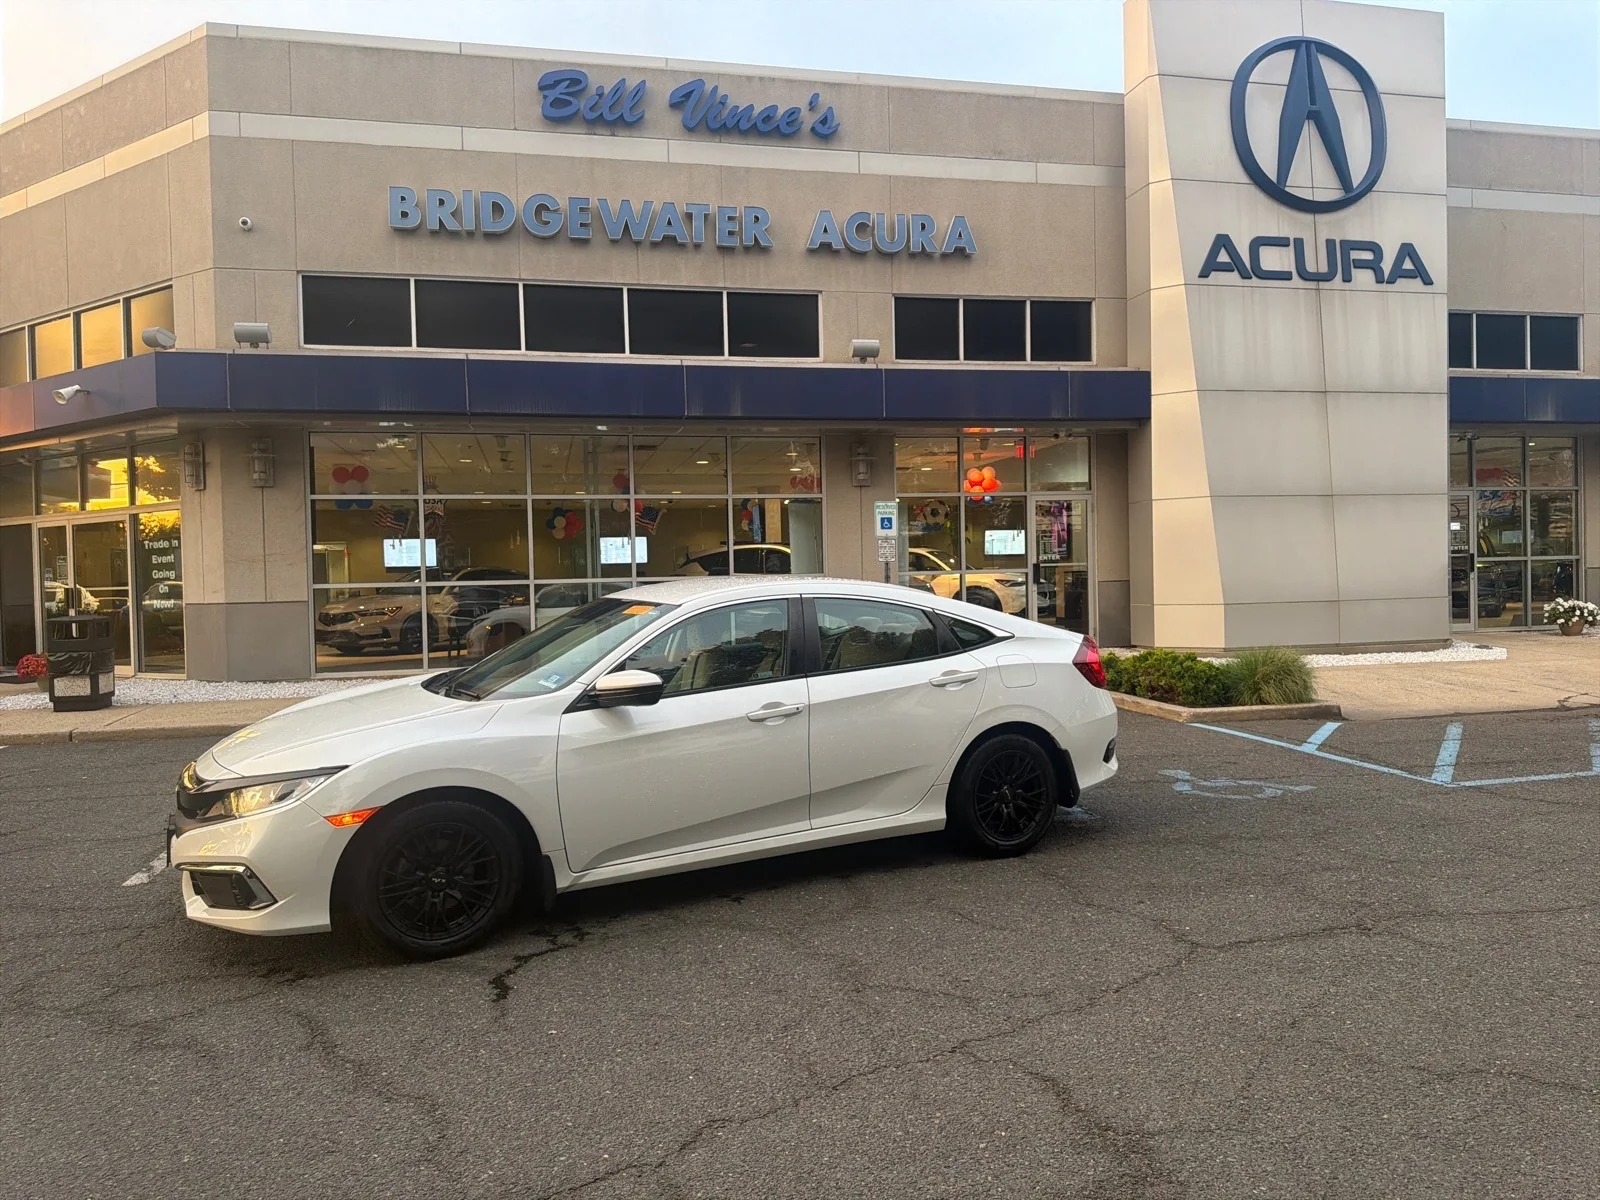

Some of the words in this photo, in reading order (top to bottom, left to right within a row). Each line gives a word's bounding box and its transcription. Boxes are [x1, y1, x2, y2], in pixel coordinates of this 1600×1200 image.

[537, 68, 646, 126] Bill
[668, 78, 840, 138] Vince's
[388, 185, 774, 249] BRIDGEWATER
[806, 209, 978, 256] ACURA
[1198, 233, 1434, 286] ACURA
[143, 540, 169, 550] Trade
[151, 554, 175, 564] Event
[152, 569, 176, 580] Going
[158, 584, 169, 594] On
[153, 599, 174, 609] Now!
